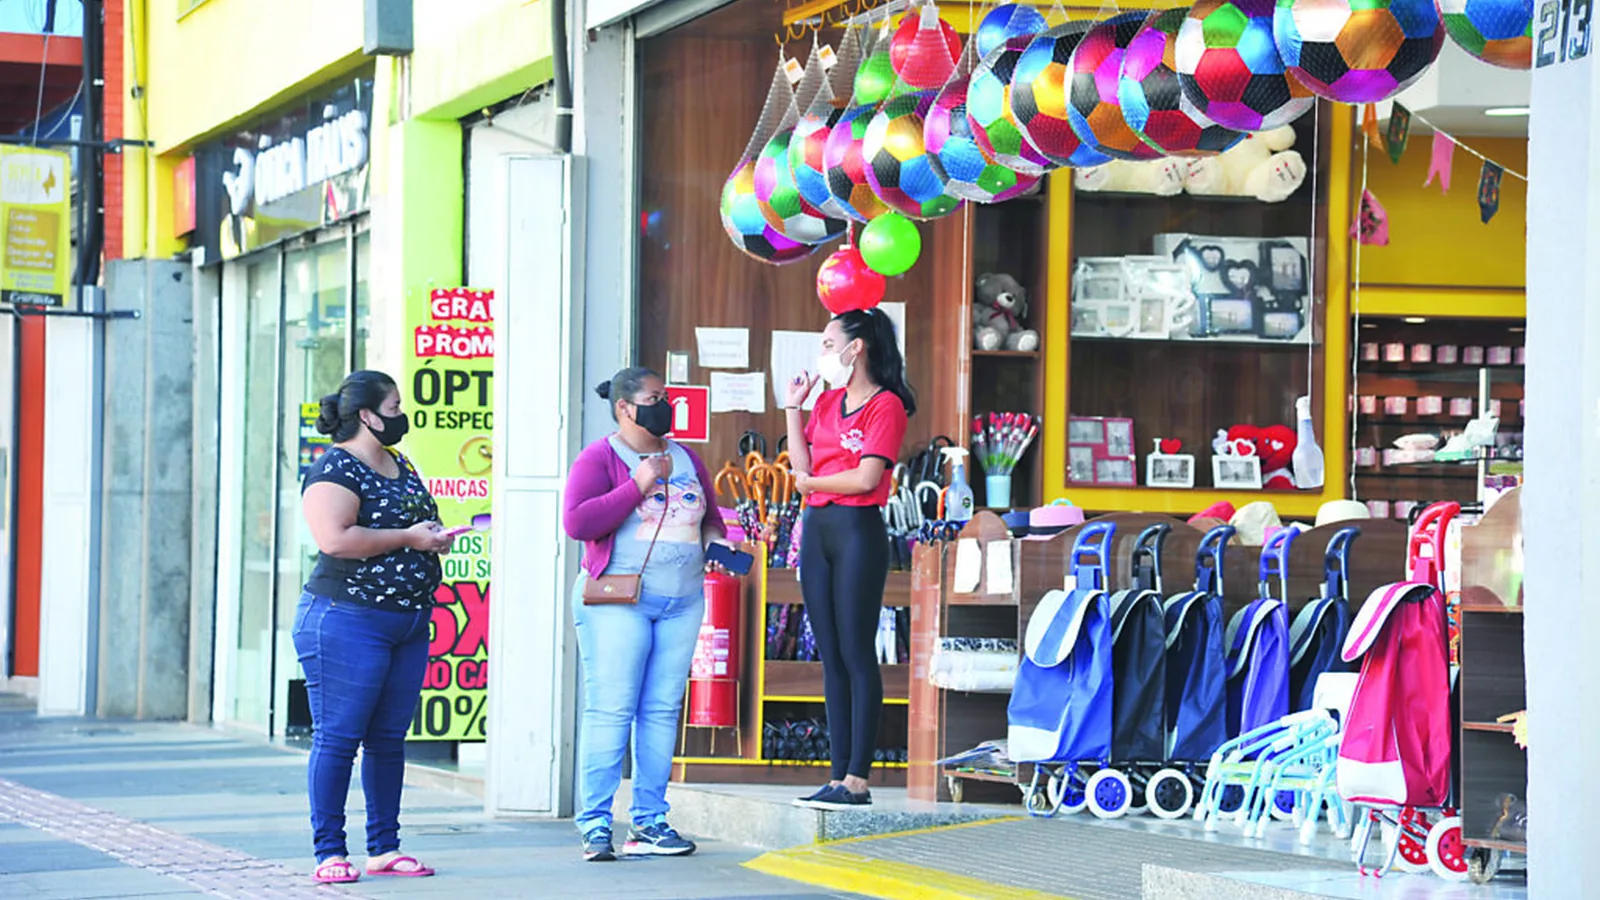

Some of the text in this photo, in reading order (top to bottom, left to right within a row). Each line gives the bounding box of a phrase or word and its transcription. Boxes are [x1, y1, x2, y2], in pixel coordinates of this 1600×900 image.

[1536, 0, 1593, 68] 213
[417, 333, 493, 356] PROM
[413, 358, 493, 406] ÓPT
[435, 411, 493, 430] ESPEC
[444, 559, 491, 578] OU S
